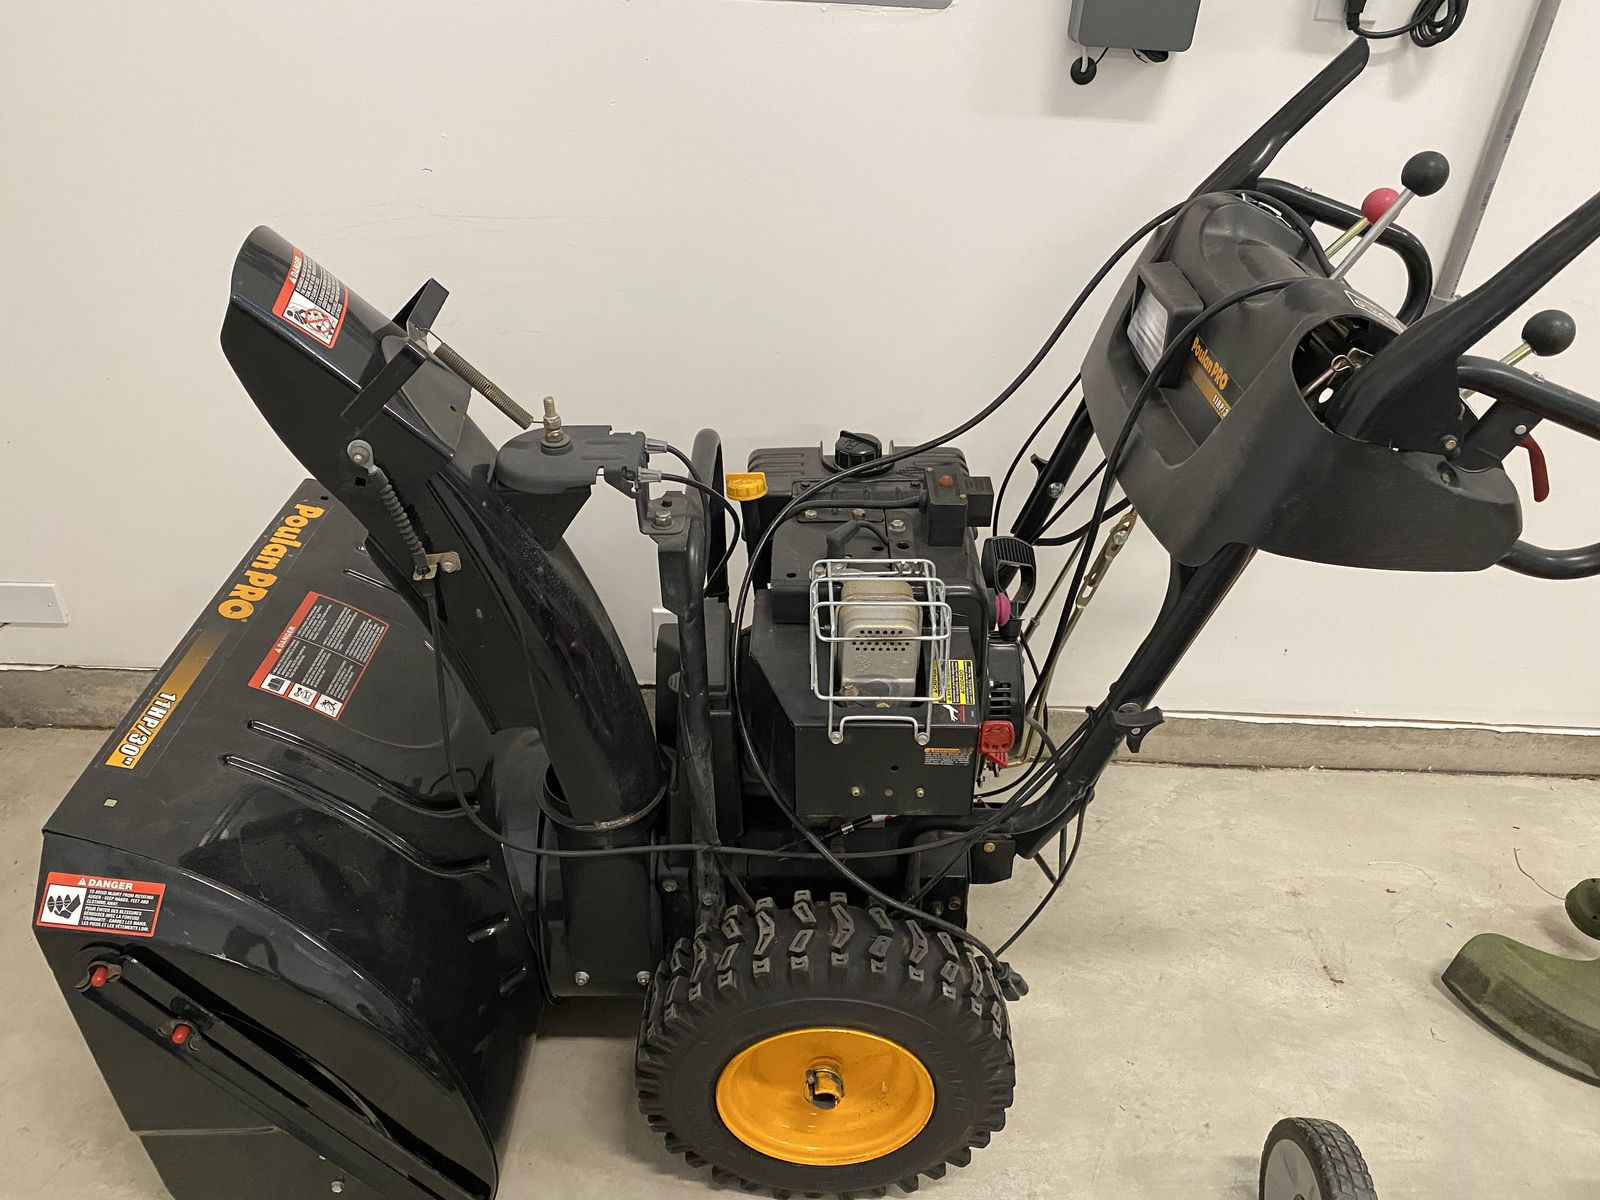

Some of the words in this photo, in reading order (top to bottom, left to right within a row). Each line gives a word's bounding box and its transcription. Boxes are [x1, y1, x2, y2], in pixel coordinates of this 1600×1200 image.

[1191, 336, 1213, 374] Poulan
[1210, 361, 1229, 390] PRO
[251, 503, 325, 570] Poulan
[218, 570, 279, 619] PRO
[279, 626, 295, 650] DANGER
[119, 692, 176, 767] 11HP/30"
[88, 879, 133, 890] DANGER
